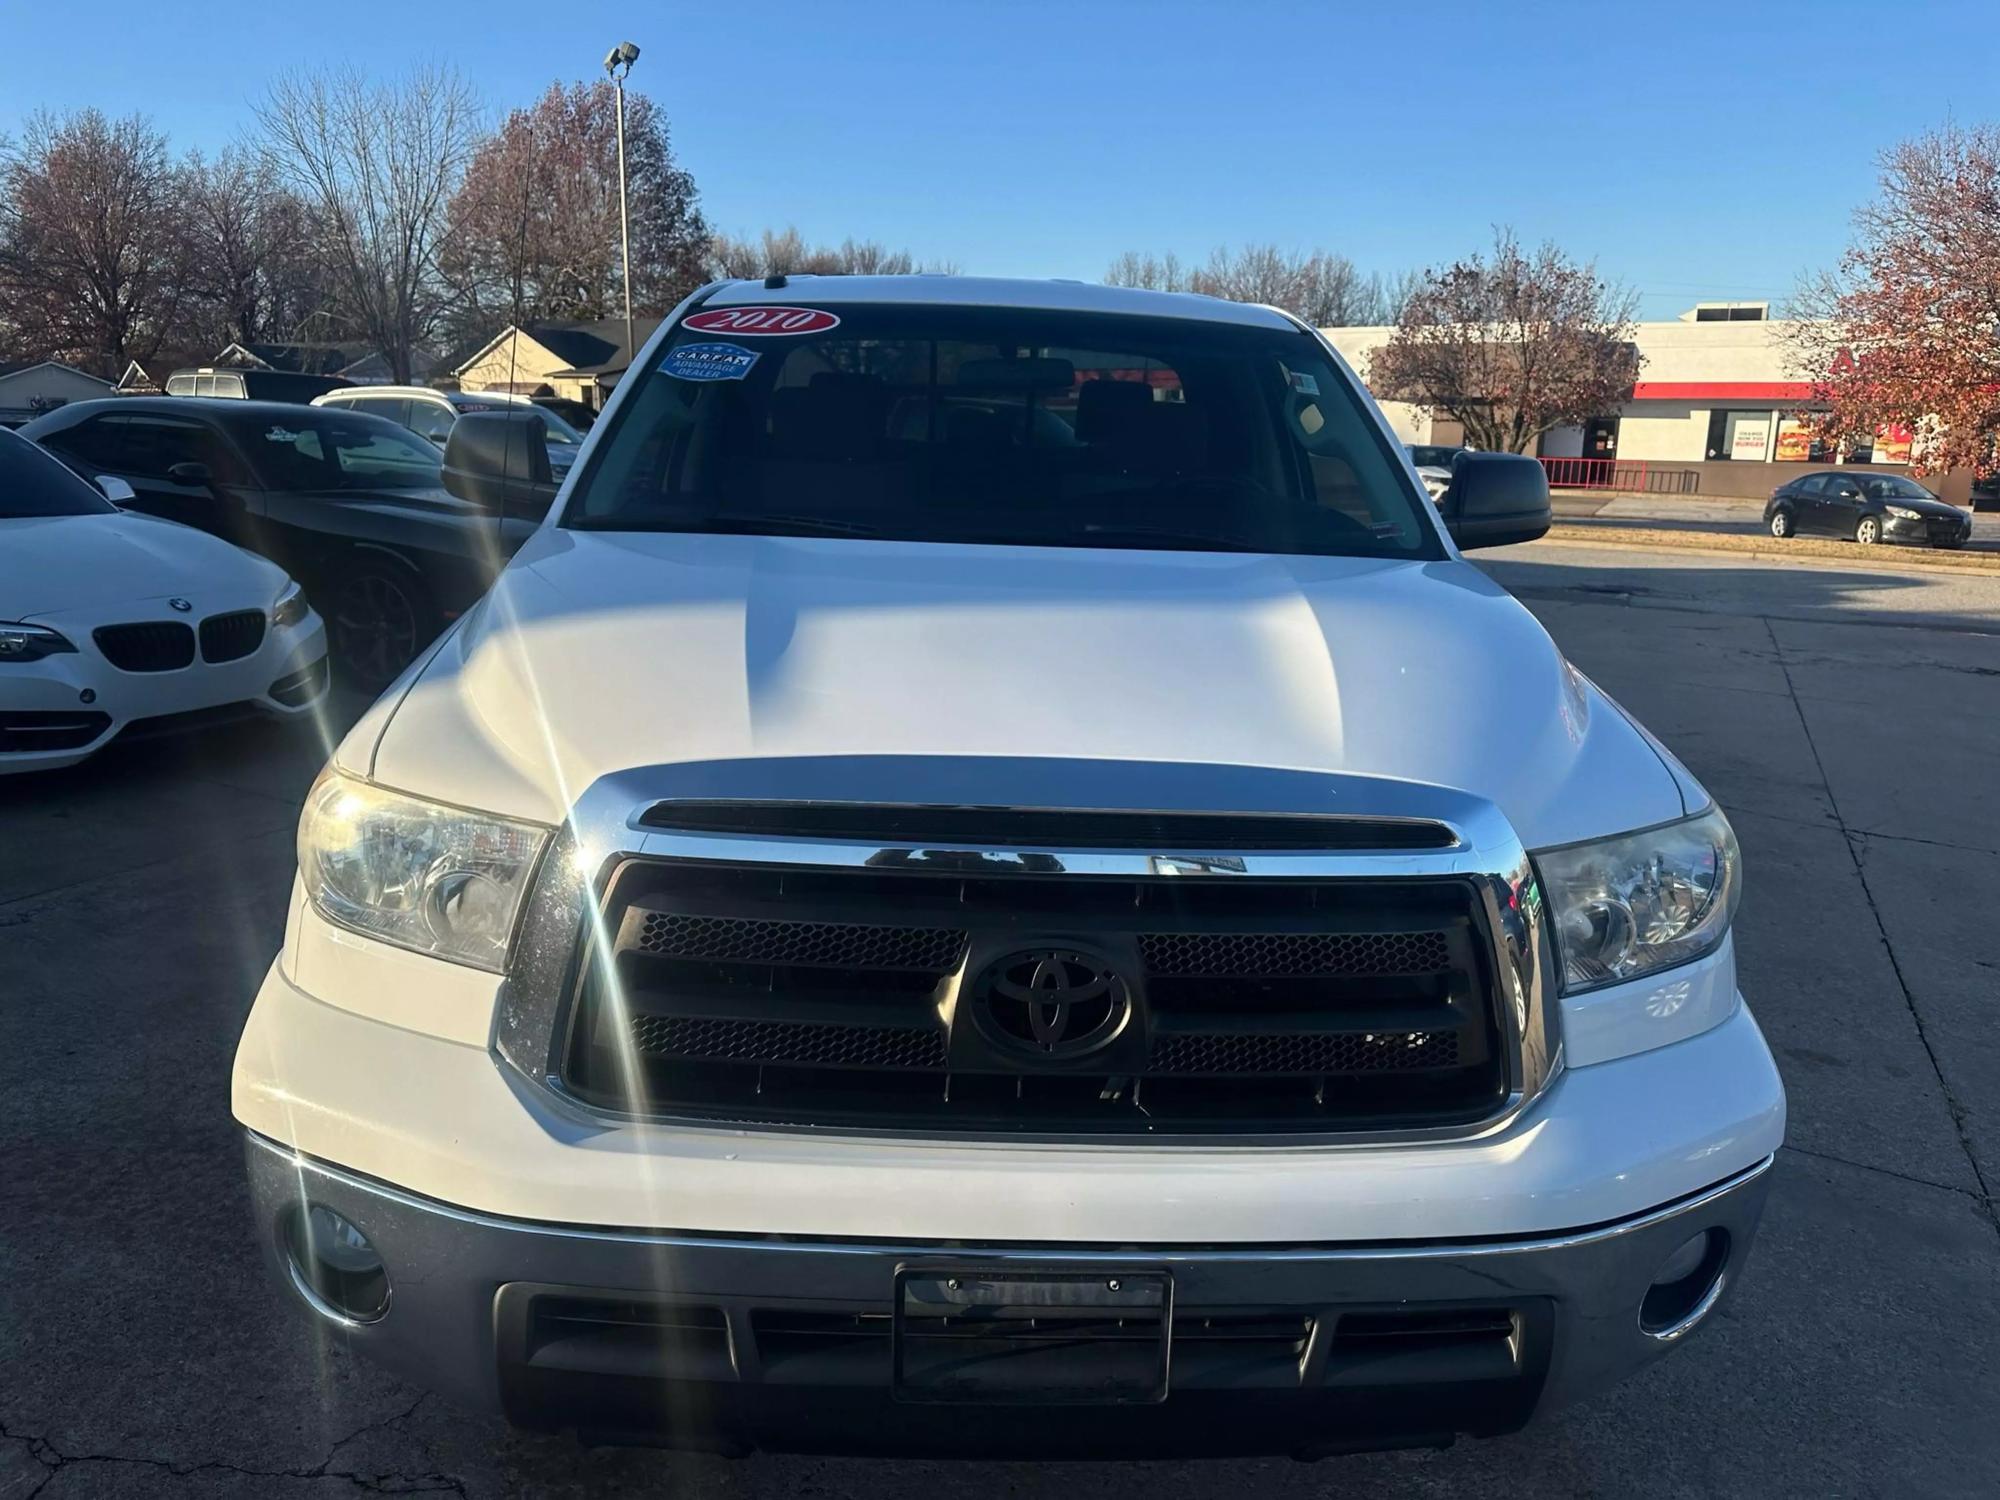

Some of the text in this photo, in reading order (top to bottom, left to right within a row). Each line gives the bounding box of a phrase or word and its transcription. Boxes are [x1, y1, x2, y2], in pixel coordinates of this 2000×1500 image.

[703, 311, 816, 329] 2010
[676, 351, 751, 366] CARFAX
[672, 360, 737, 372] ADVANTAGE
[677, 367, 721, 378] DEALER
